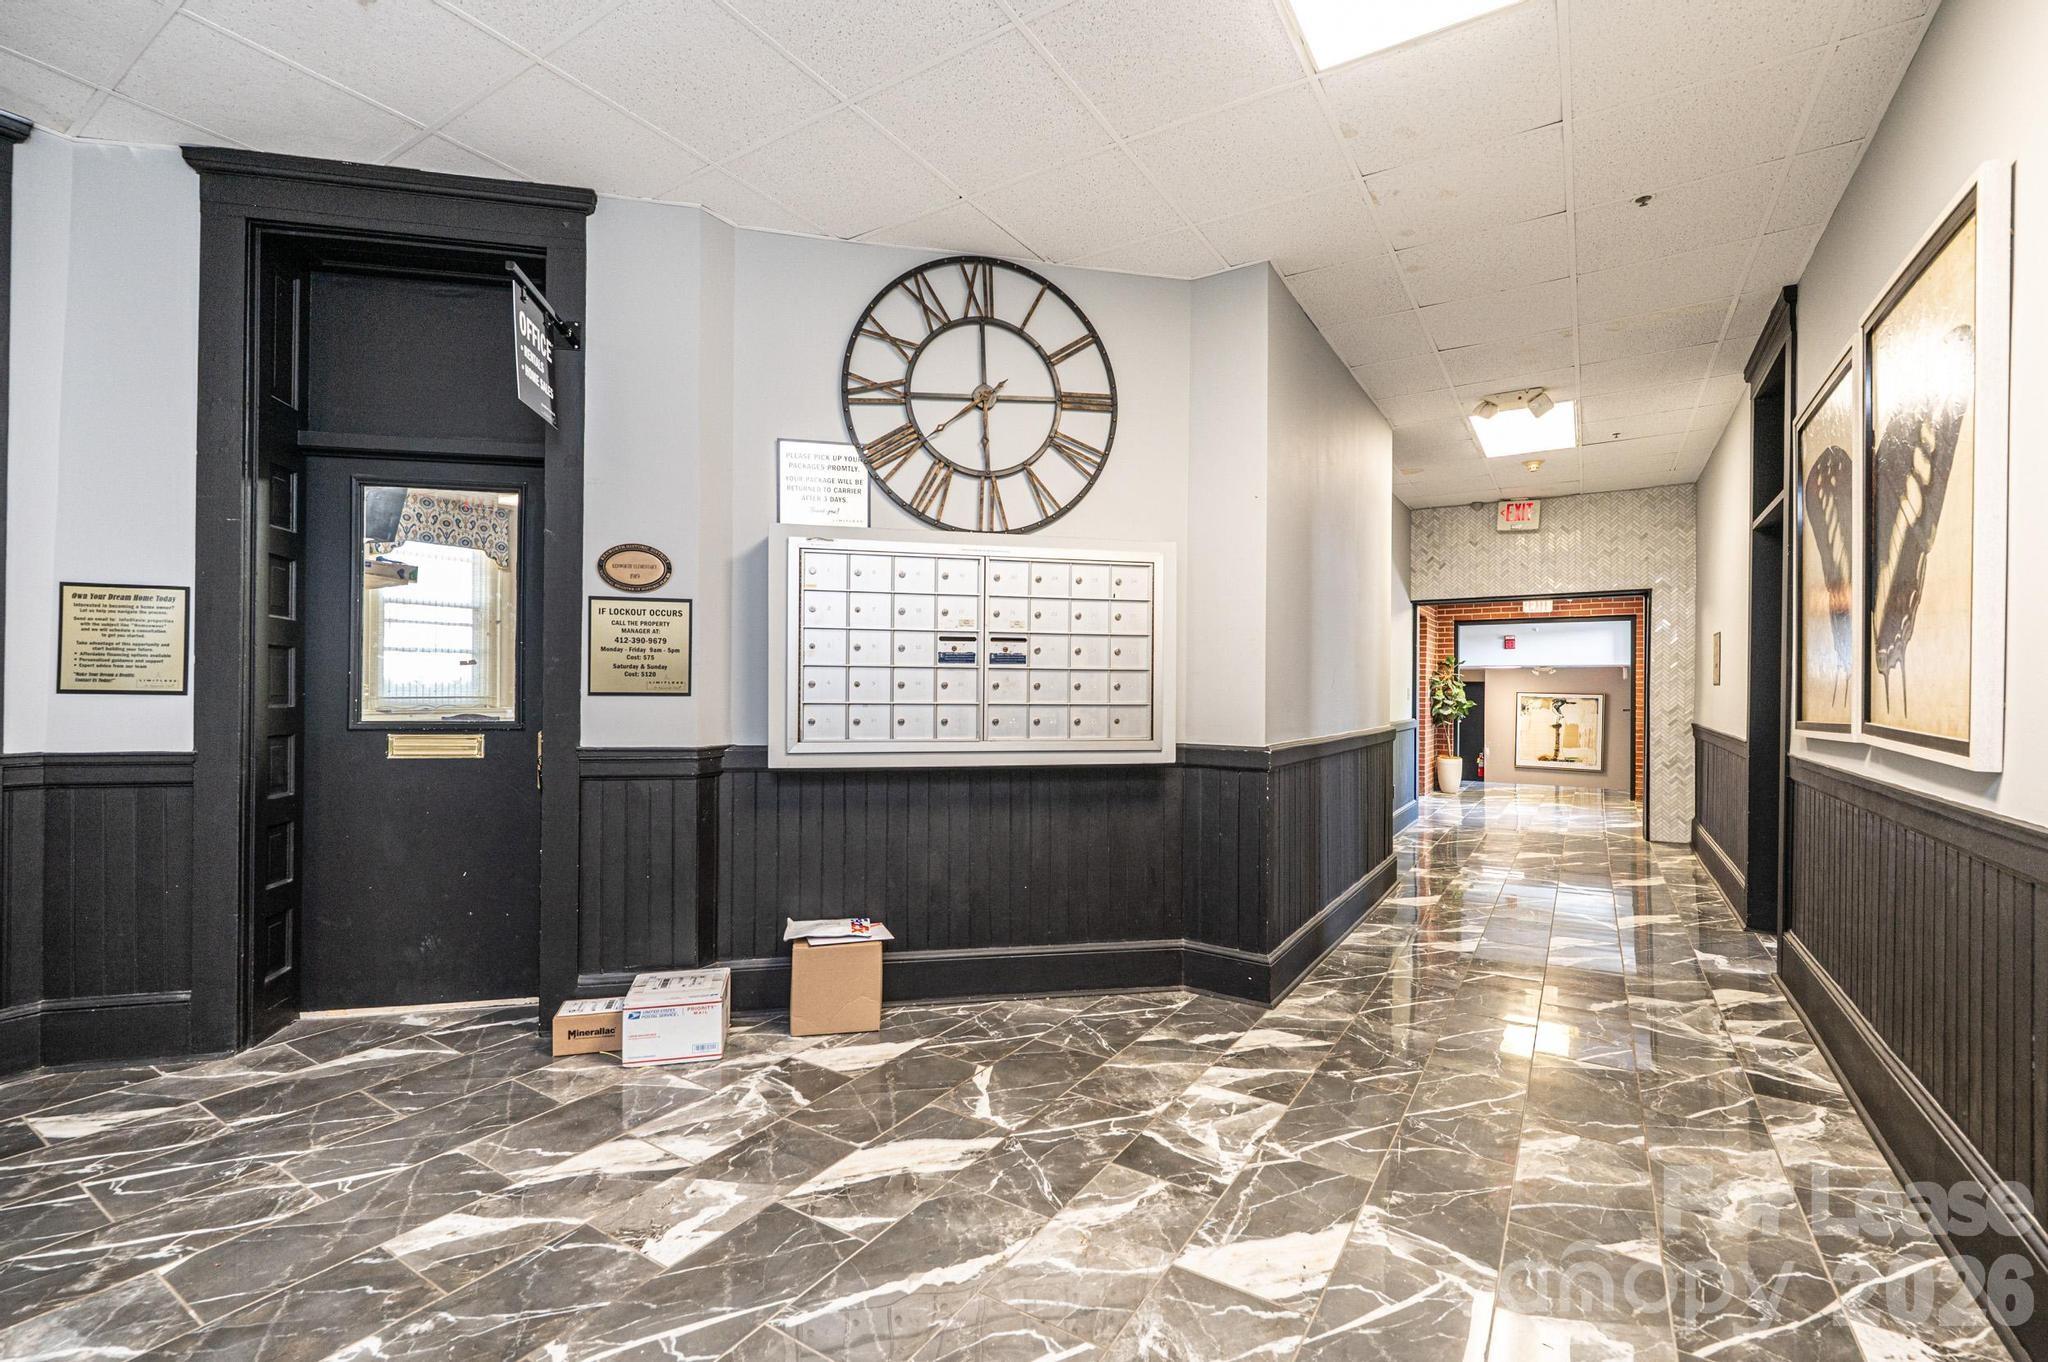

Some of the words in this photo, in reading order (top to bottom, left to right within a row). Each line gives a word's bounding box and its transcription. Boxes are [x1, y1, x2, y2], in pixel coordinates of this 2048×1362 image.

[519, 310, 553, 364] OFFICE
[523, 344, 545, 374] RENTALS
[524, 364, 541, 388] HOME
[539, 376, 554, 400] SALES
[814, 453, 830, 461] PICK
[788, 462, 825, 470] PACKAGES
[805, 476, 835, 484] PACKAGE
[1505, 502, 1534, 521] EXIT
[108, 593, 132, 601] Dream
[155, 595, 176, 603] Today
[609, 608, 647, 616] LOCKOUT
[649, 609, 683, 617] OCCURS
[614, 637, 667, 645] 412-390-9679
[568, 1027, 616, 1040] Minerallac
